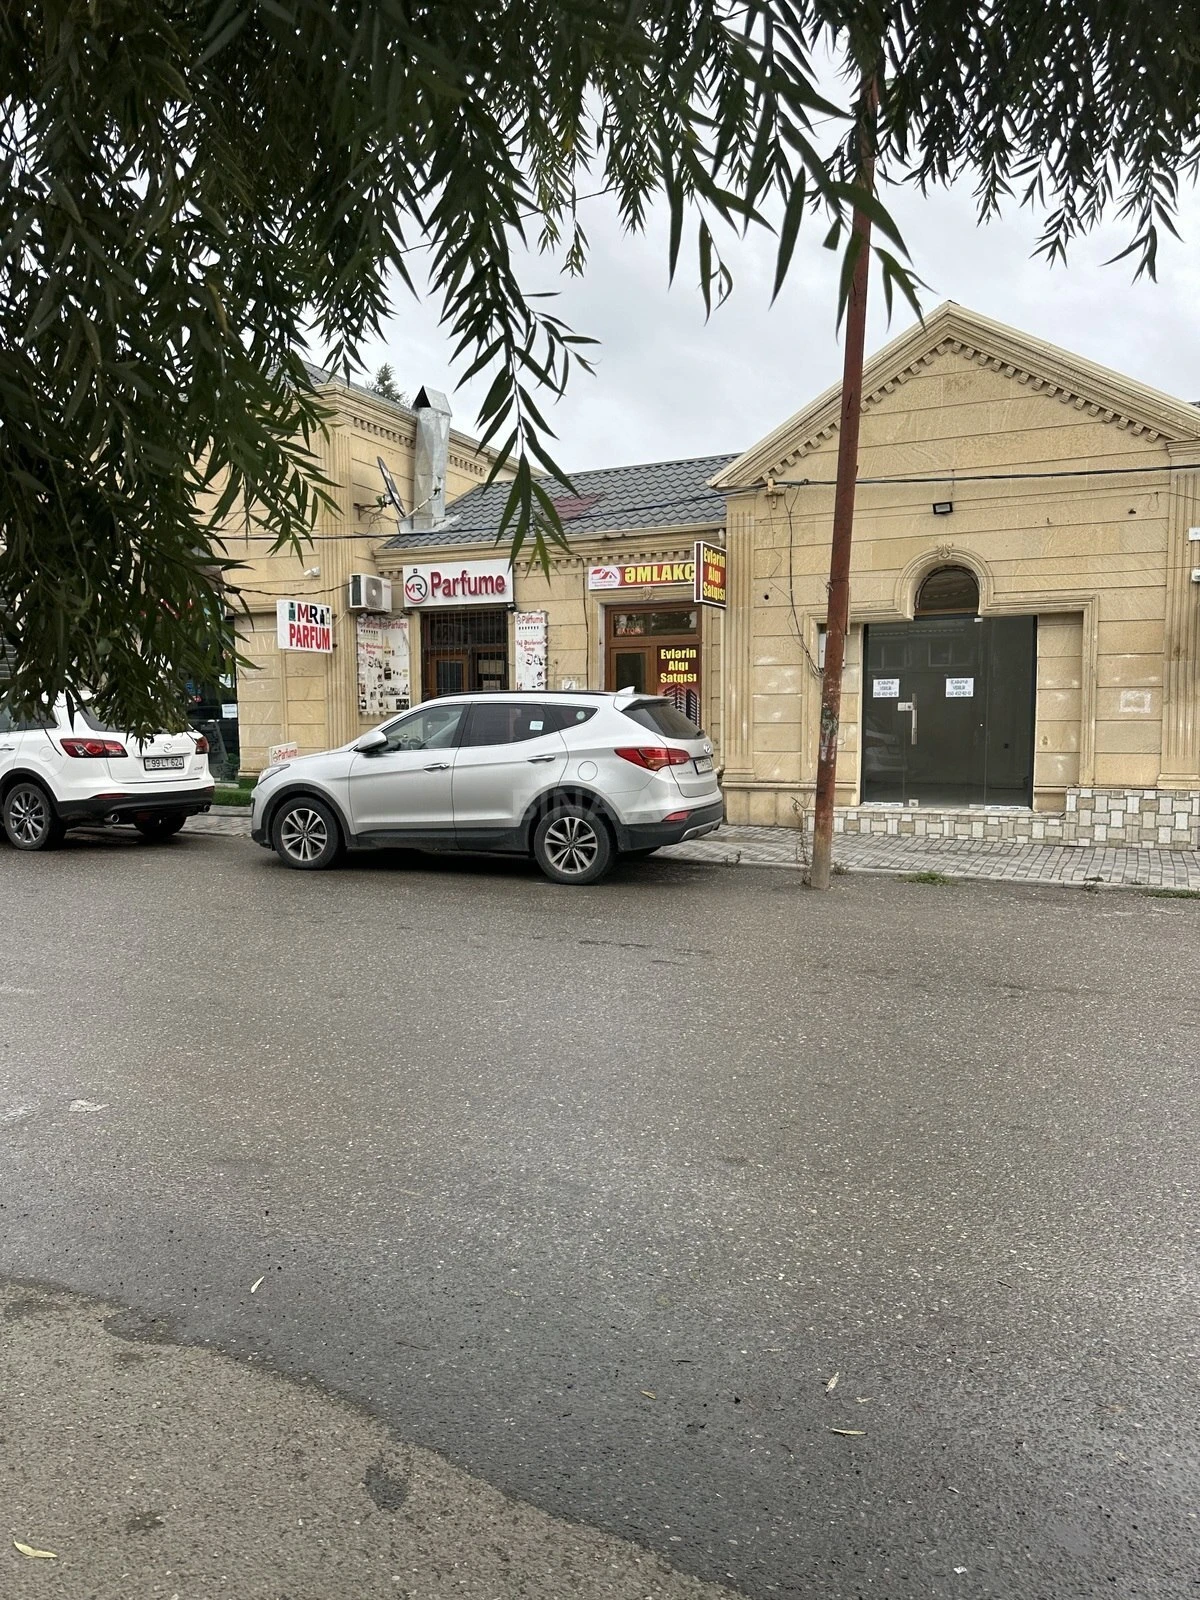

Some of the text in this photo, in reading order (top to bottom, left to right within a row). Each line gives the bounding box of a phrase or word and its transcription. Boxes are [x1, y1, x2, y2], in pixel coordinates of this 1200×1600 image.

[703, 547, 726, 569] Evlərin
[708, 567, 721, 583] Alqı
[430, 570, 506, 597] Parfume
[703, 583, 726, 601] Satqısı
[289, 623, 330, 650] PARFUM
[660, 649, 697, 659] Evlərin
[668, 661, 689, 671] Alqı
[660, 673, 697, 684] Satqısı
[151, 759, 160, 767] 99
